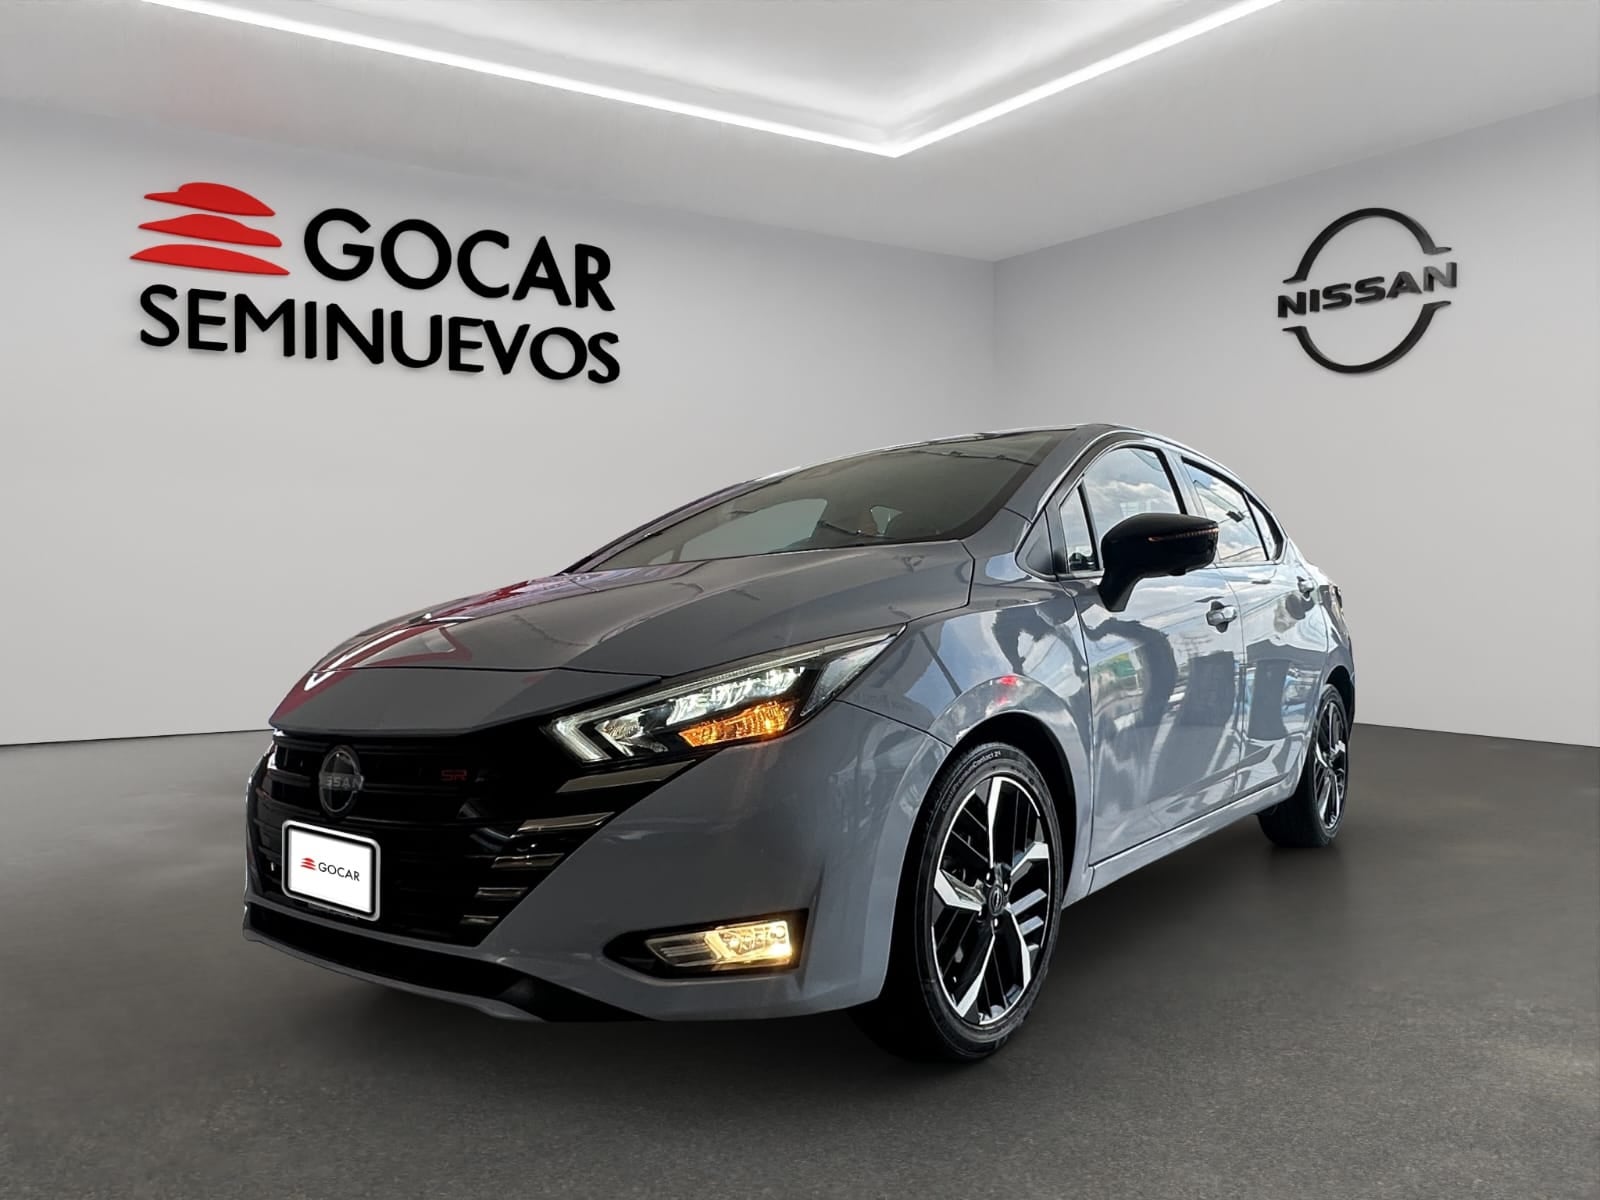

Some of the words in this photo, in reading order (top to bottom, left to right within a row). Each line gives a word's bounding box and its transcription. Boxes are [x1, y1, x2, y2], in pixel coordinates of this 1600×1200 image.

[303, 207, 616, 313] GOCAR
[1277, 262, 1458, 319] NISSAN
[139, 284, 621, 385] SEMINUEVOS
[318, 861, 361, 882] GOCAR
